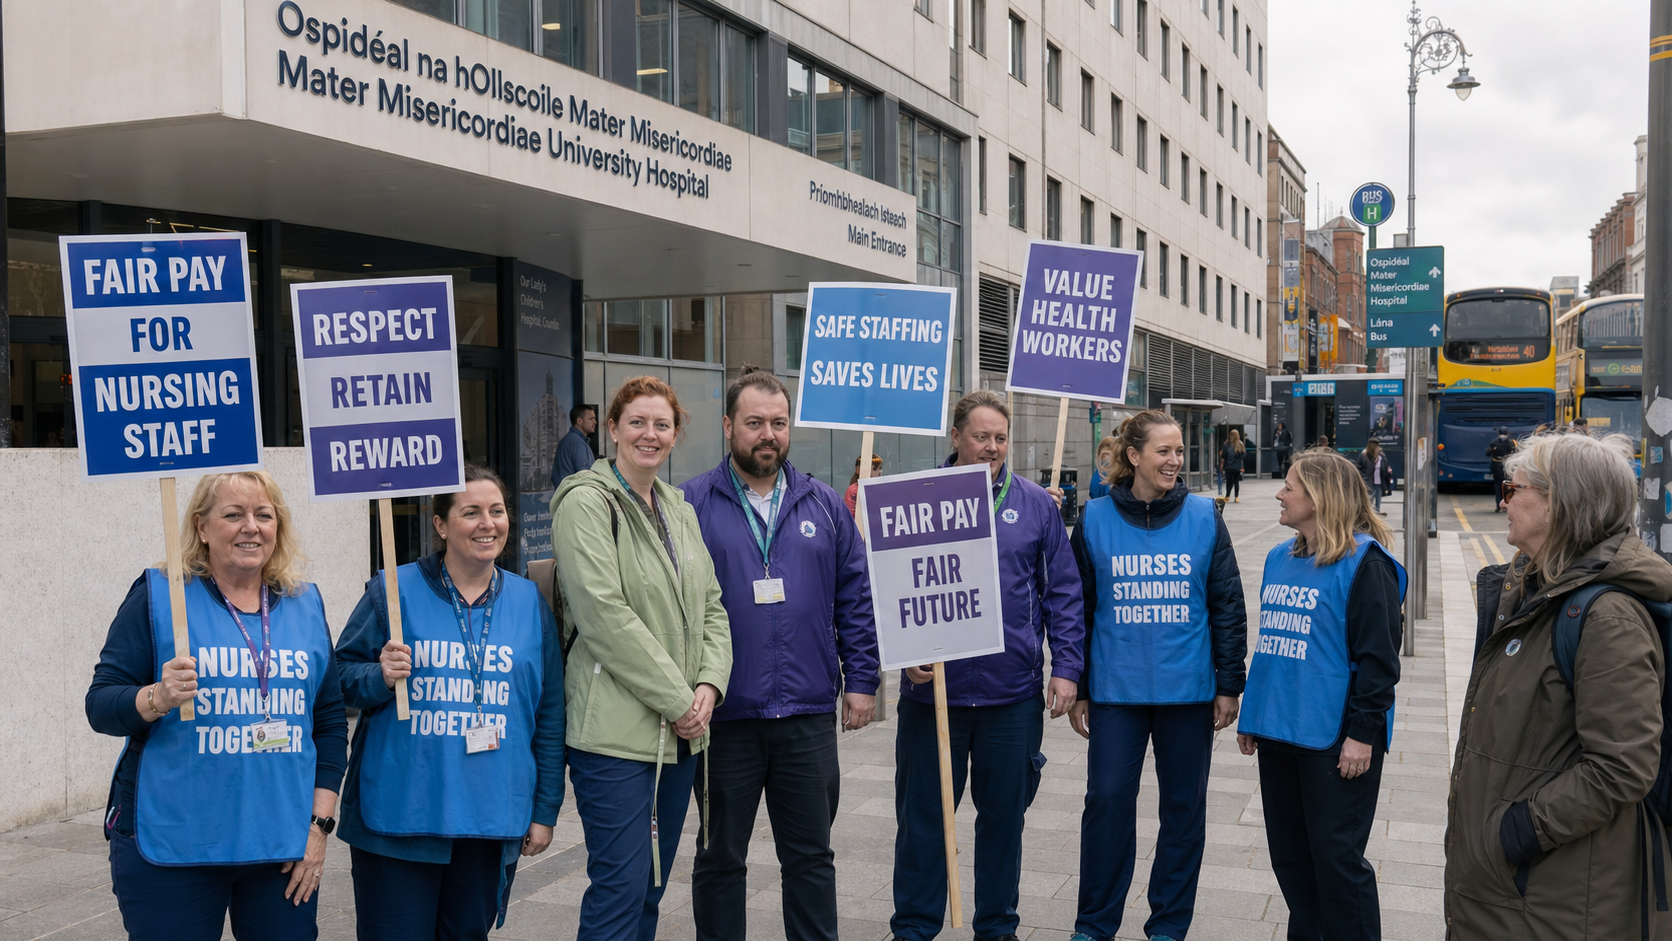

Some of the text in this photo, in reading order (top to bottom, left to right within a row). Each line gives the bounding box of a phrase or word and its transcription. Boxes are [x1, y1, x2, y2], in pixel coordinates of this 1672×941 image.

[277, 0, 733, 172] Ospidéal na hOllscoile Mater Misericordiae
[277, 49, 710, 200] Mater Misericordiae University Hospital
[880, 204, 907, 230] Isteach
[1367, 206, 1377, 220] H
[848, 224, 907, 258] Main Entrance
[83, 255, 227, 296] FAIR PAY
[1370, 256, 1410, 269] Ospidéal
[1370, 270, 1397, 280] Mater
[1044, 268, 1115, 300] VALUE
[1370, 281, 1430, 293] Misericordiae
[1031, 299, 1117, 333] HEALTH
[1370, 295, 1408, 307] Hospital
[130, 316, 193, 353] FOR
[313, 307, 437, 346] RESPECT
[814, 314, 943, 344] SAFE STAFFING
[1370, 318, 1394, 328] Lána
[1370, 331, 1388, 341] Bus
[1022, 329, 1122, 363] WORKERS
[1523, 345, 1535, 358] 40
[94, 370, 240, 413] NURSING
[330, 371, 433, 409] RETAIN
[810, 360, 939, 393] SAVES LIVES
[123, 418, 216, 459] STAFF
[329, 434, 443, 472] REWARD
[879, 497, 980, 538] FAIR PAY
[911, 553, 963, 588] FAIR
[1111, 553, 1192, 577] NURSES
[1112, 580, 1190, 600] STANDING
[1261, 584, 1320, 610] NURSES
[898, 588, 982, 629] FUTURE
[1113, 604, 1190, 624] TOGETHER
[411, 676, 510, 706] STANDNG
